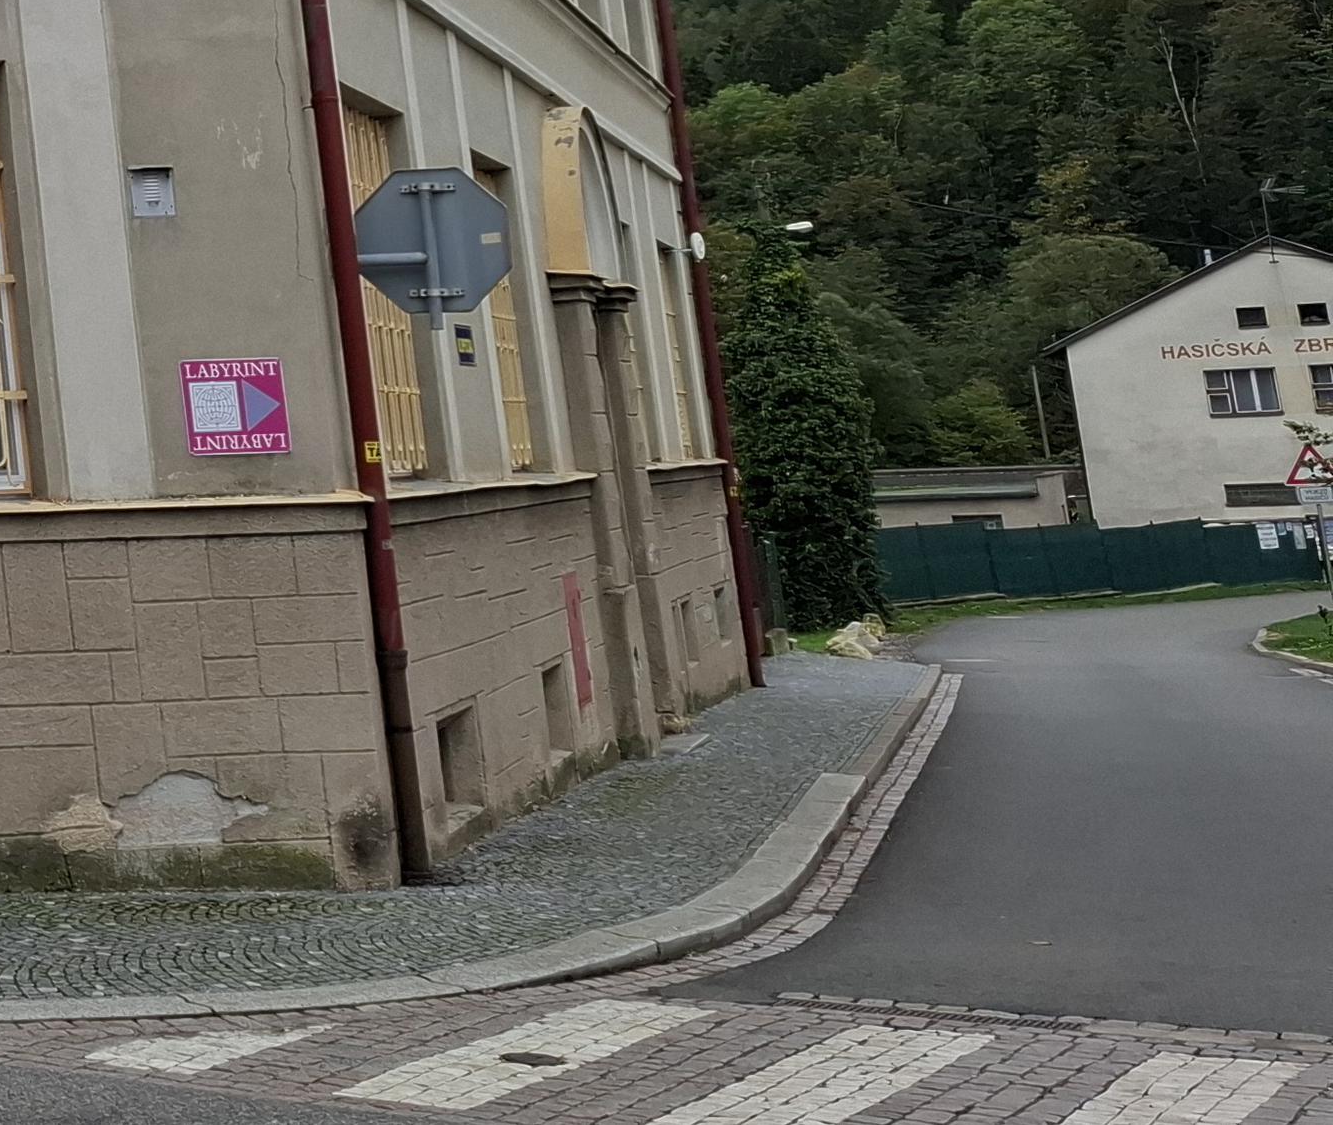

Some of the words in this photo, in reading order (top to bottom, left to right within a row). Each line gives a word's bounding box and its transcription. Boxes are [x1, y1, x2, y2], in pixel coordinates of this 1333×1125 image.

[1161, 336, 1272, 359] HASIČSKÁ
[184, 361, 278, 378] LABYRINT
[193, 433, 287, 451] LABYRINT
